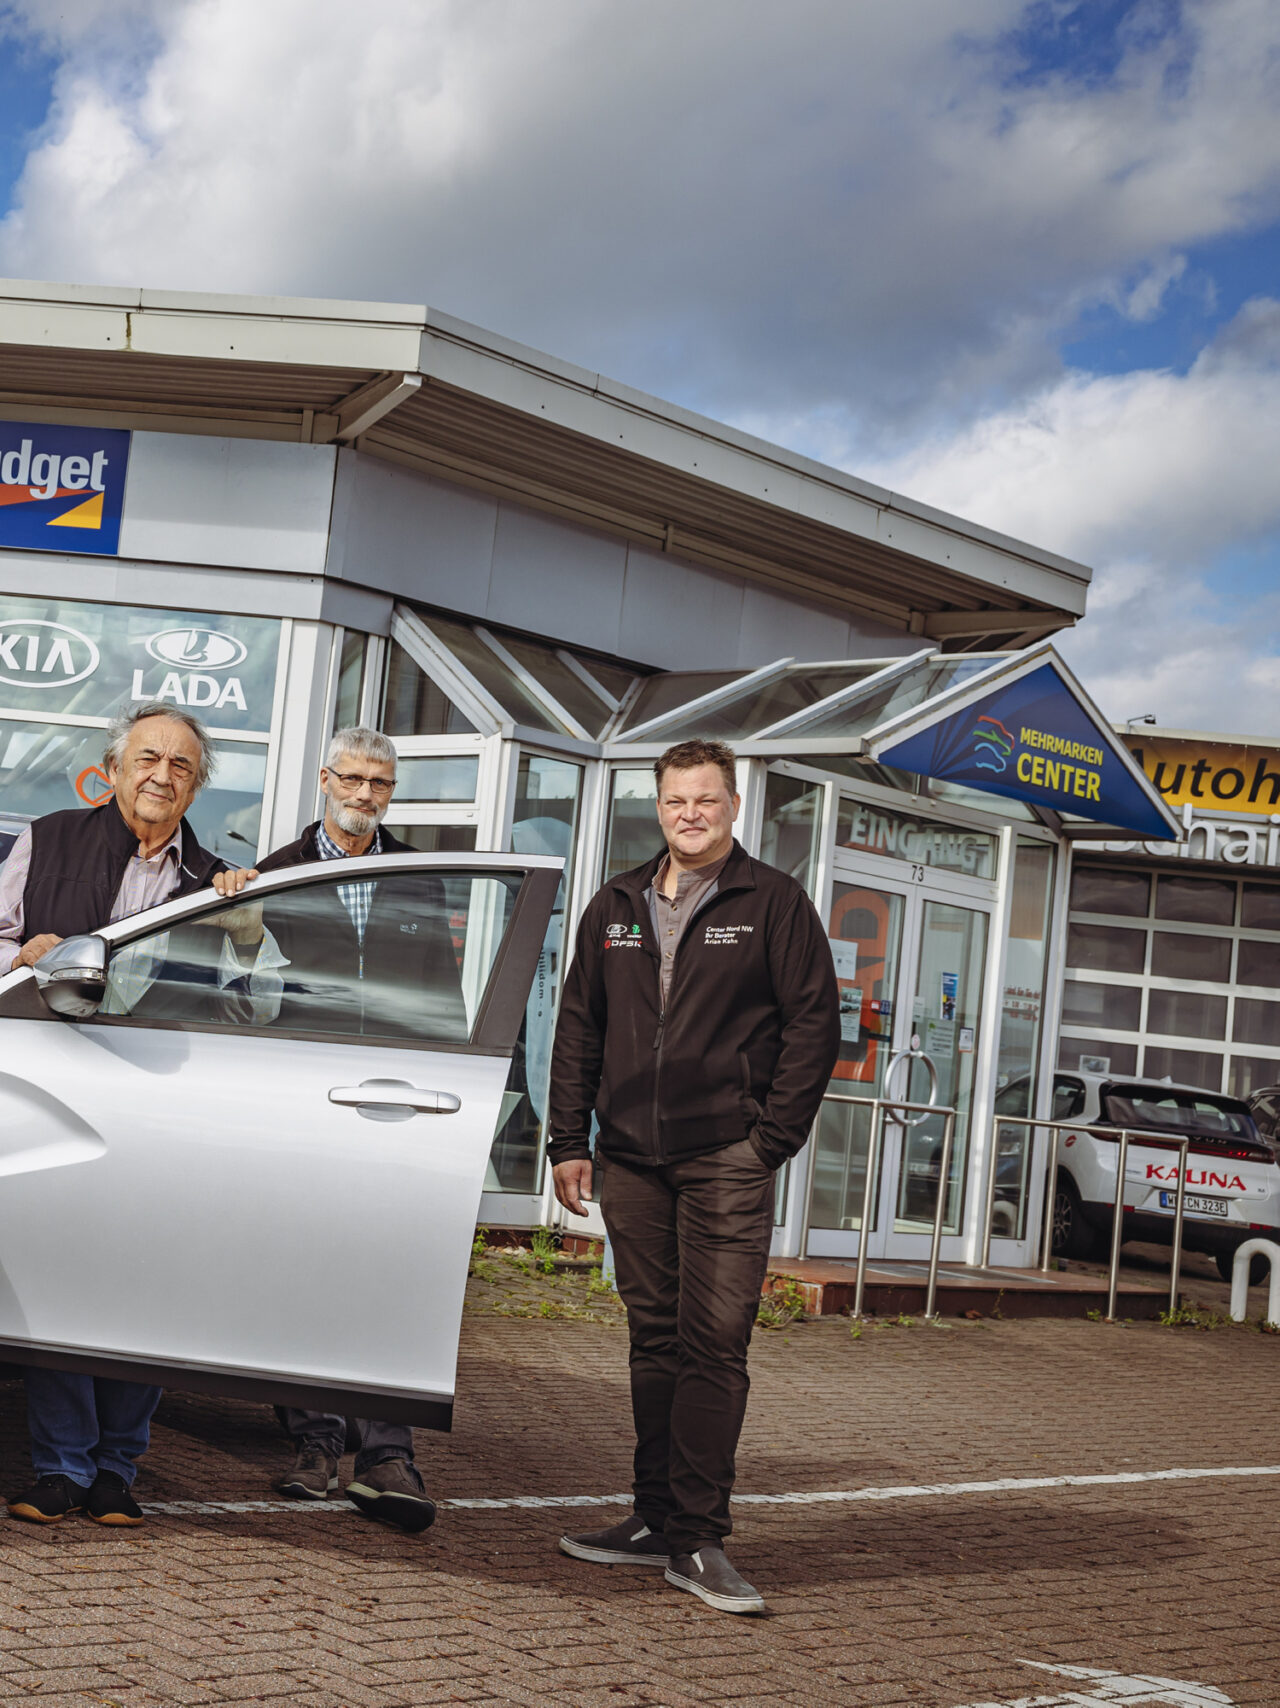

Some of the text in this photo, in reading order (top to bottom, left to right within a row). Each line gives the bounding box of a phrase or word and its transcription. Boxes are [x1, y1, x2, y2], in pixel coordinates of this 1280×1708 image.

[131, 669, 248, 711] LADA
[1020, 727, 1104, 766] MEHRMARKEN
[1017, 752, 1101, 801] CENTER
[850, 811, 977, 874] EINGANG
[1104, 803, 1280, 866] hai
[912, 865, 925, 882] 73
[611, 940, 643, 948] DFSK
[1146, 1164, 1247, 1191] KALINA
